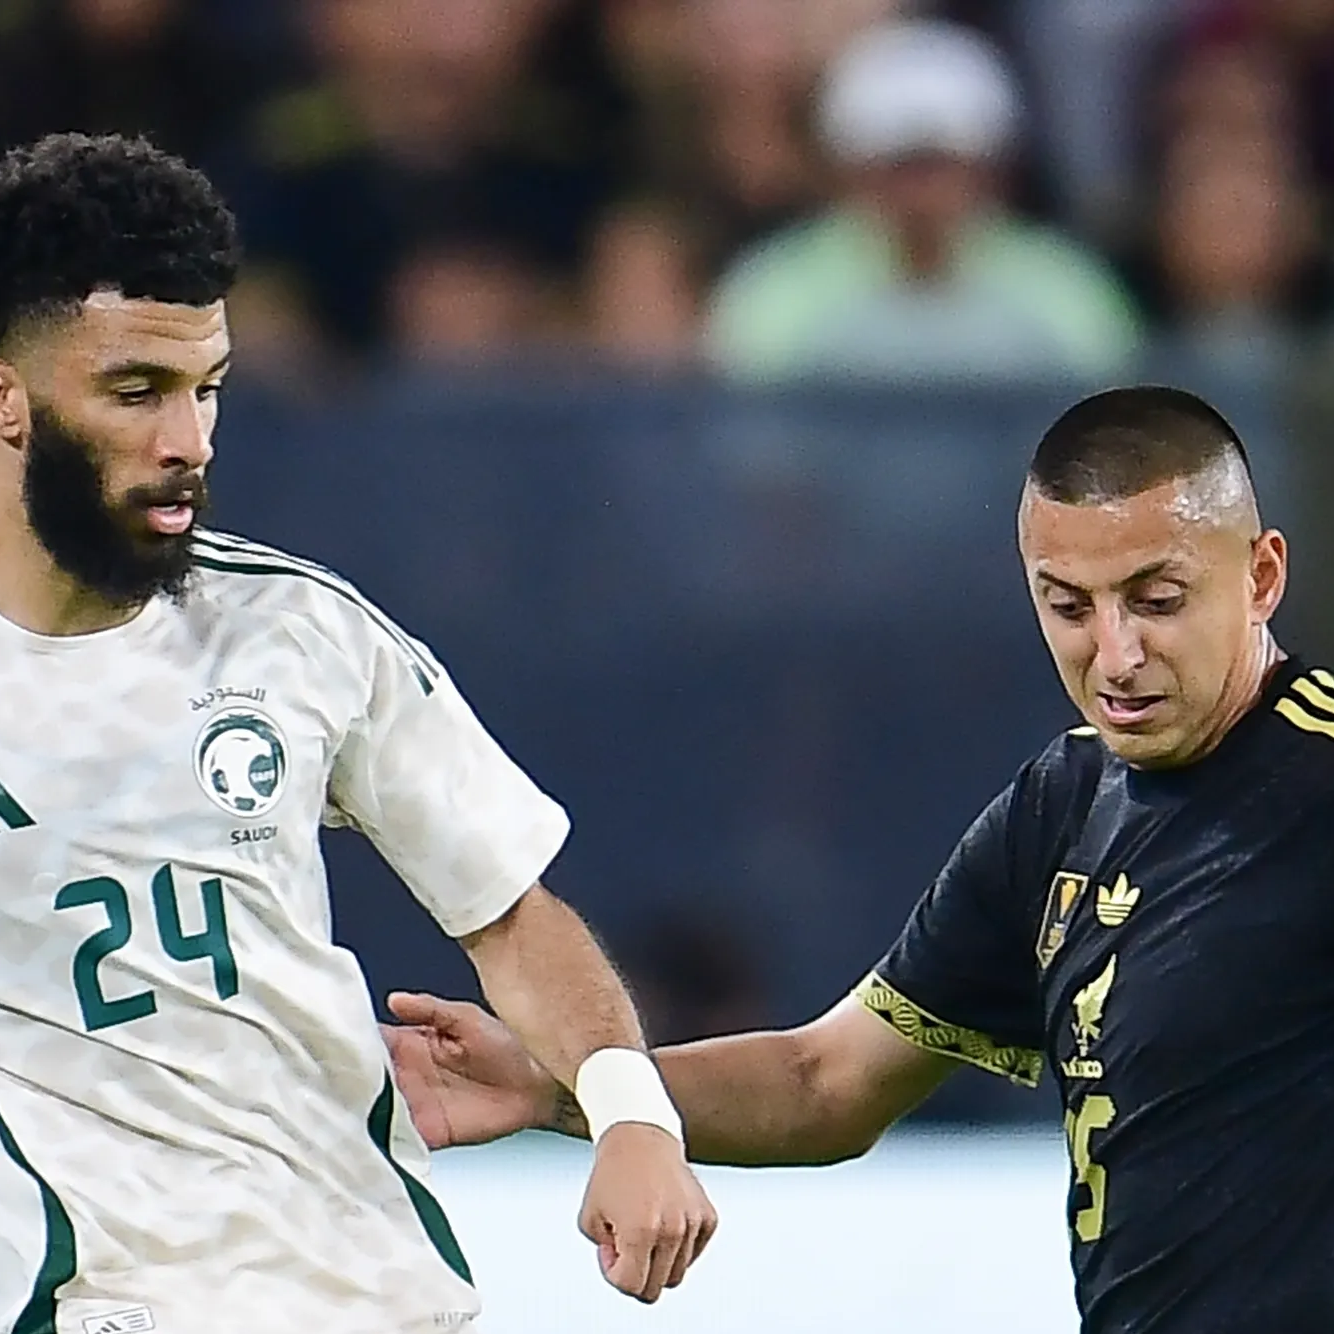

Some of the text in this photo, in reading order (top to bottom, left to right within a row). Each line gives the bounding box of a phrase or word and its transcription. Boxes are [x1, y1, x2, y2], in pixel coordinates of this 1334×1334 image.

[230, 825, 279, 846] SAUDI
[53, 861, 240, 1033] 24
[1063, 1094, 1117, 1243] 5
